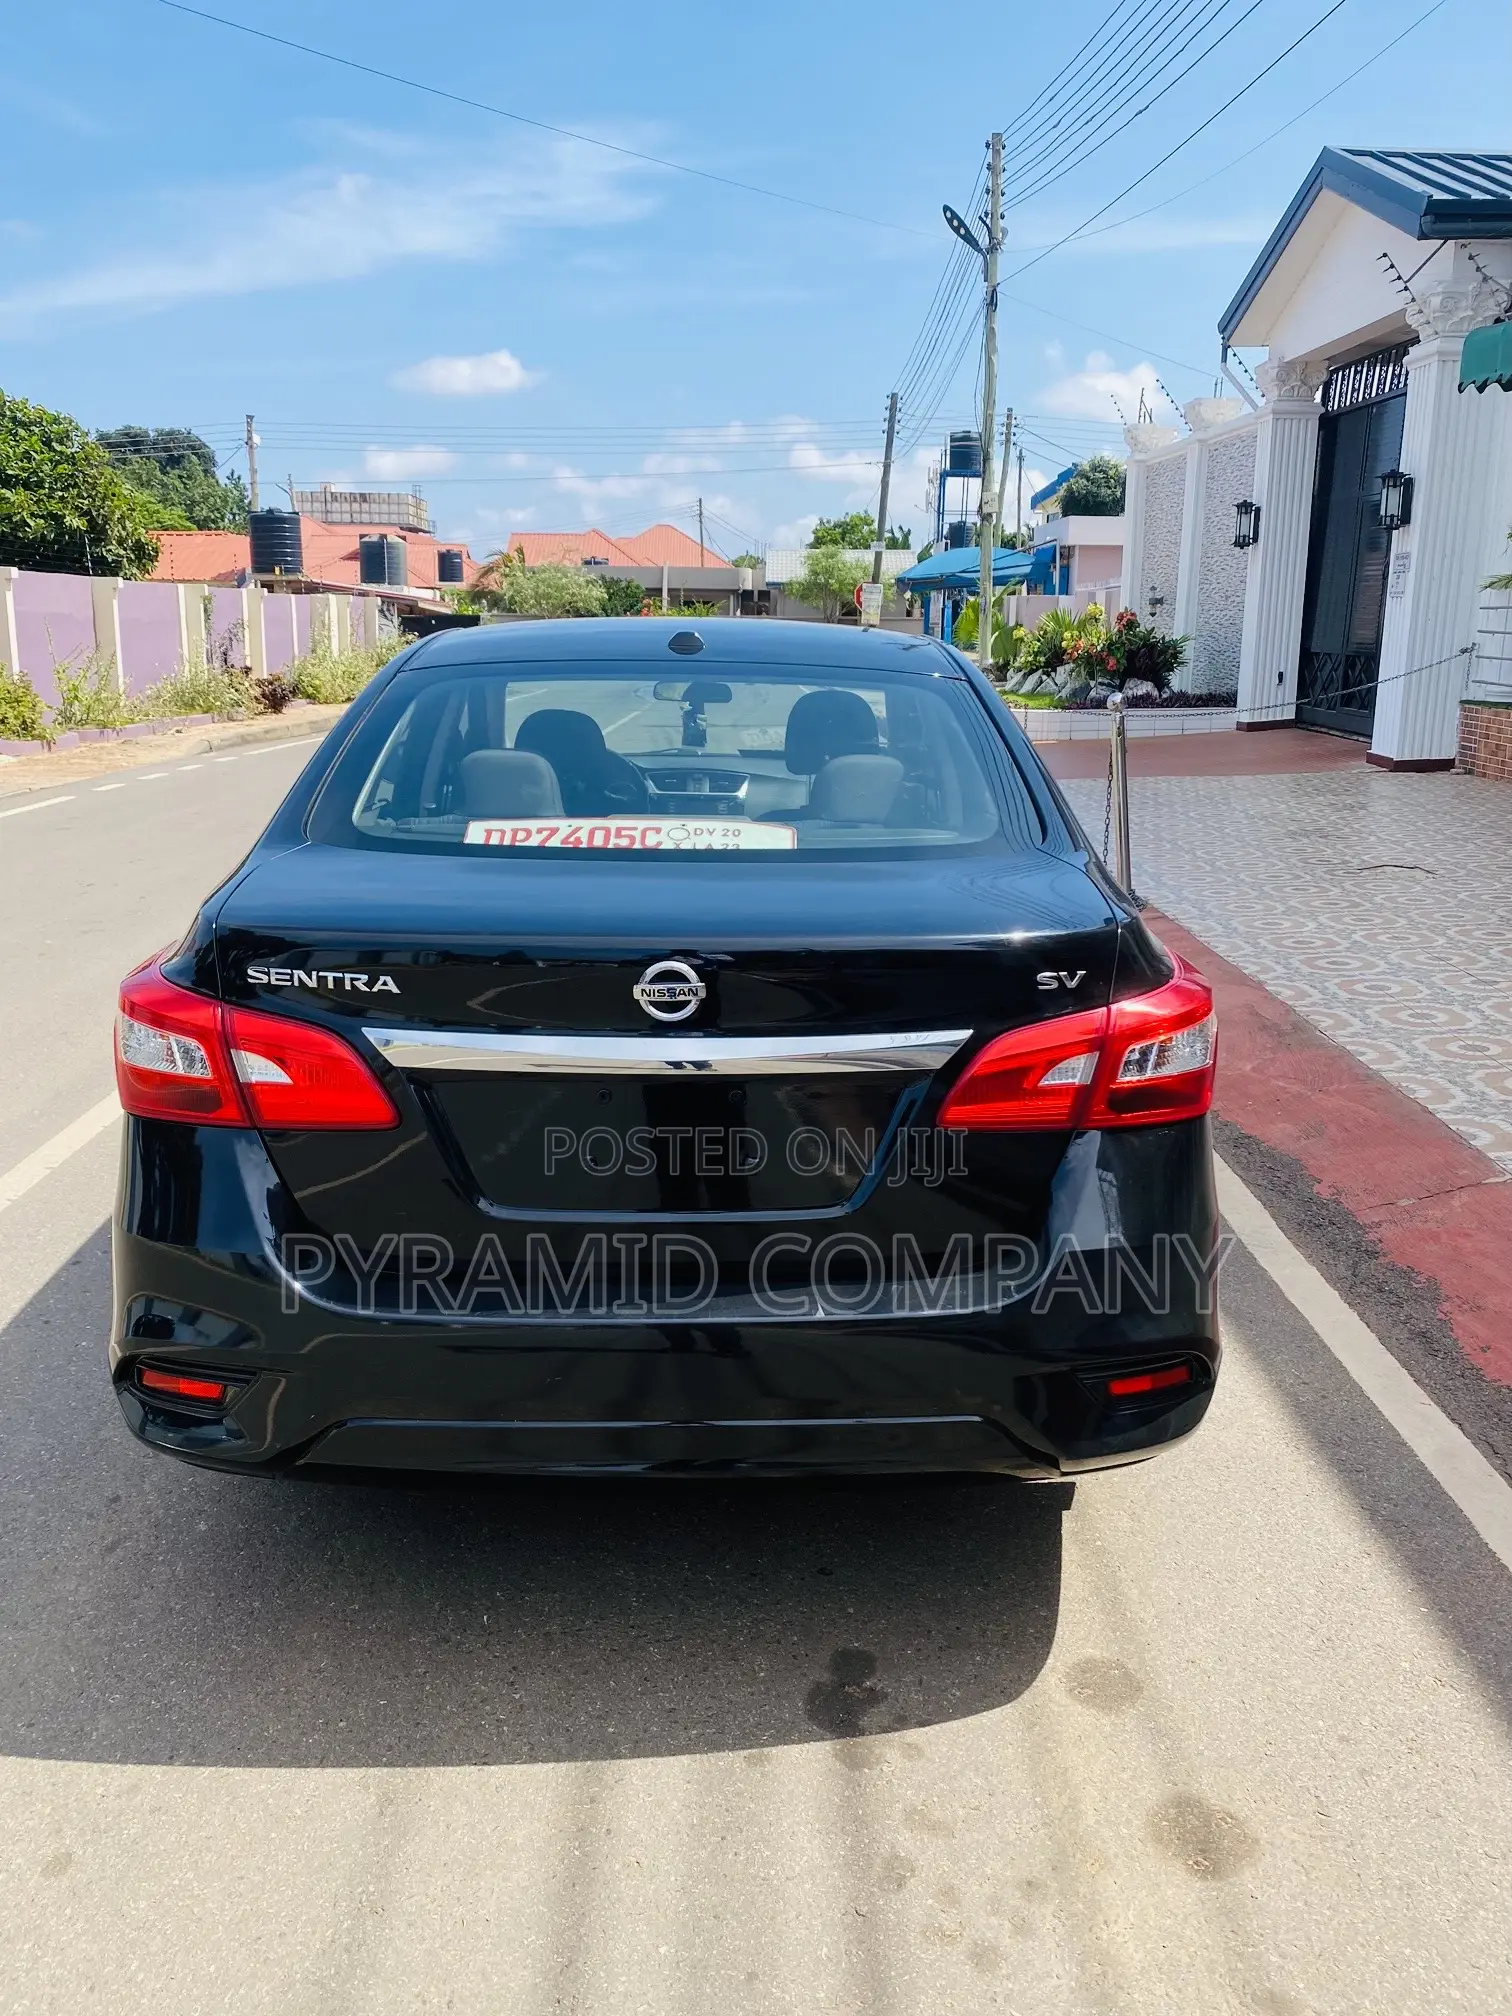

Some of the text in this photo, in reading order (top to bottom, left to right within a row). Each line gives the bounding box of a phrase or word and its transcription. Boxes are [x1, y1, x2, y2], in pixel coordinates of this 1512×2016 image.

[693, 827, 741, 837] DV 20
[247, 966, 402, 994] SENTRA
[1036, 970, 1087, 990] SV
[641, 987, 699, 999] NISSAN
